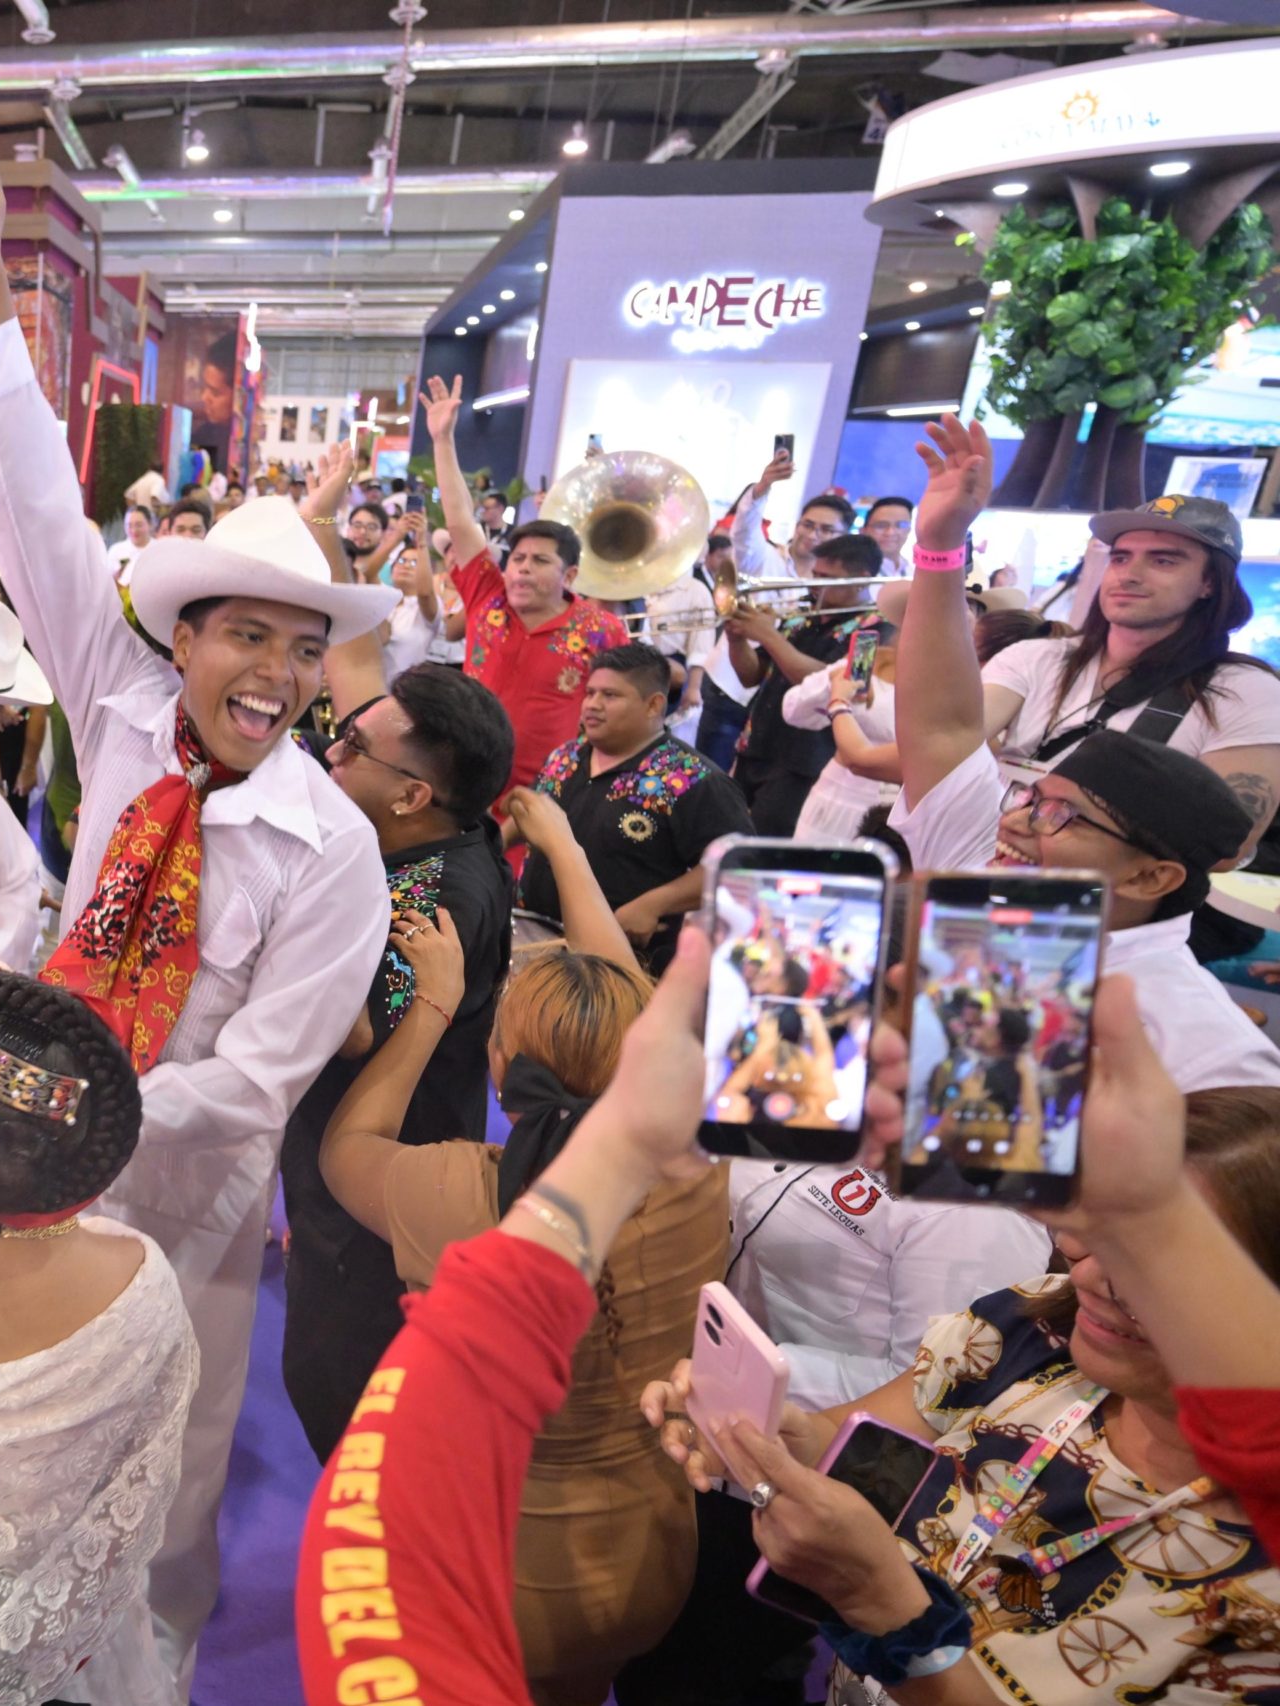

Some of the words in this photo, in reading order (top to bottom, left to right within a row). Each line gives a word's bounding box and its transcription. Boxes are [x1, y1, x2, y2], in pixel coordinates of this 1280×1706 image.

[631, 277, 821, 329] CAMPECHE
[807, 1184, 832, 1208] SIETE
[828, 1205, 865, 1237] LEGUAS
[350, 1367, 407, 1424] EL
[324, 1431, 386, 1540] REY
[321, 1546, 404, 1659] DEL
[336, 1655, 424, 1706] C
